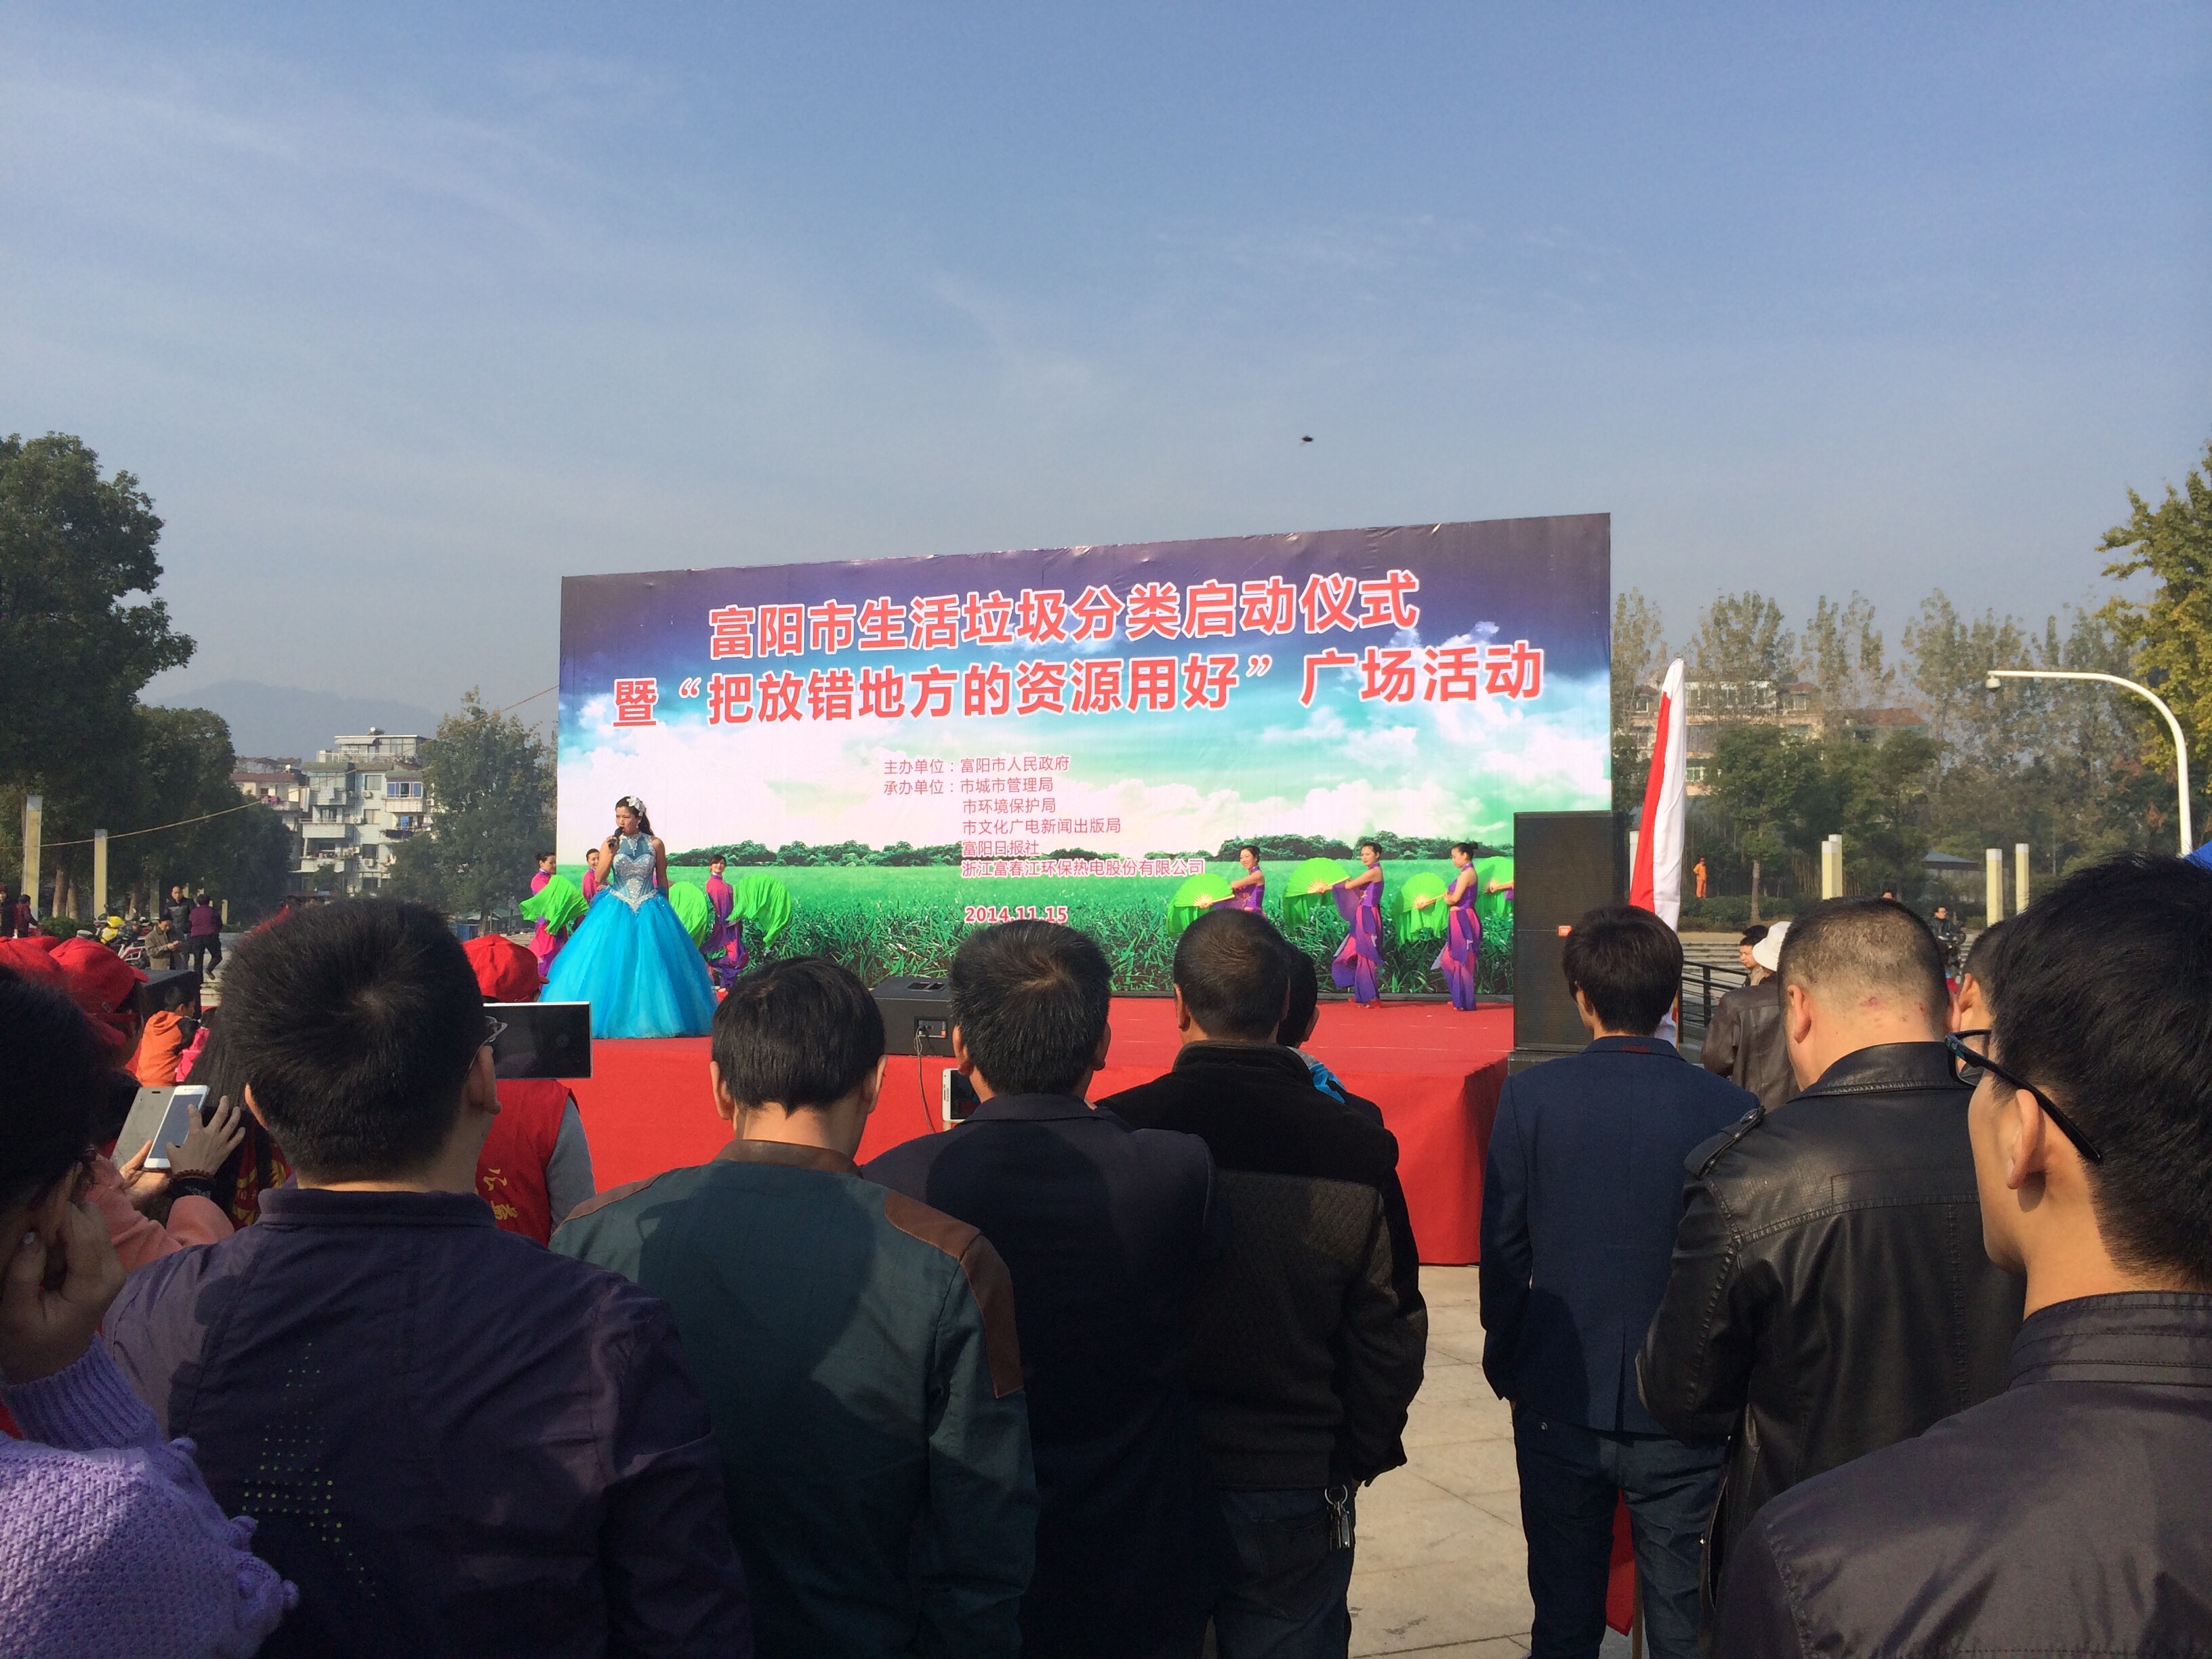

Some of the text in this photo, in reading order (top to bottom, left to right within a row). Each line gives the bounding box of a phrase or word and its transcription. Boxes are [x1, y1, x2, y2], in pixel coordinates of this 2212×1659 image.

[708, 570, 1420, 659] 富阳市生活垃圾分类启动仪式
[962, 798, 1056, 815] 市环境保护局
[962, 817, 1122, 836] 市文化广电新闻出版局
[961, 839, 1040, 857] 富阳日报社
[960, 858, 1206, 878] 浙江富春江环保热电股份有限公司
[965, 907, 1068, 923] 2014.11.15
